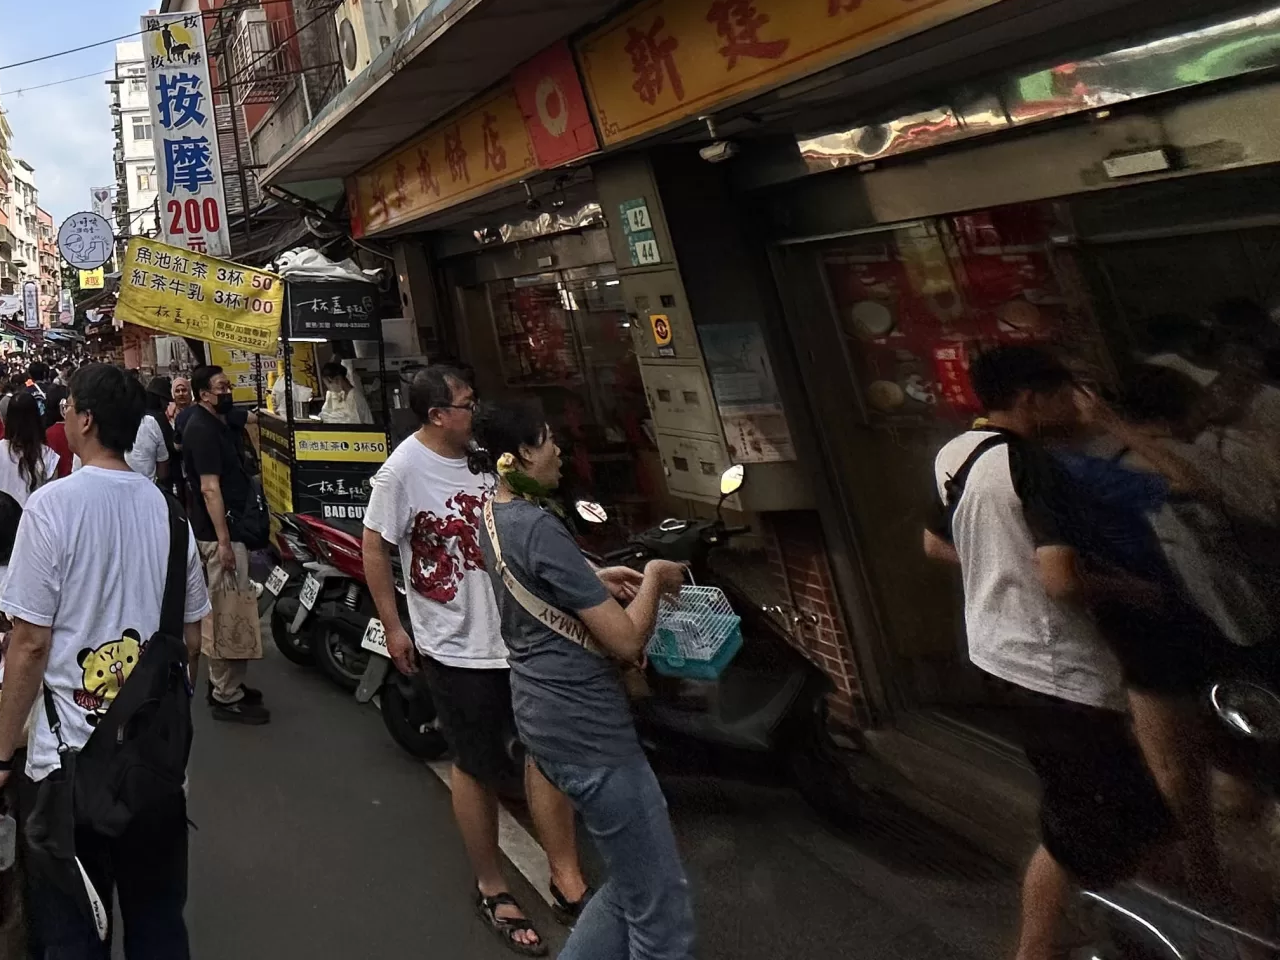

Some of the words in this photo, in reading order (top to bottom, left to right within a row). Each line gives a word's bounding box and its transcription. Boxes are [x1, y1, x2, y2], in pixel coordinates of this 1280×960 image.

[155, 71, 215, 194] 按摩
[166, 197, 220, 235] 200
[632, 209, 645, 228] 42
[187, 236, 208, 254] 元
[641, 243, 654, 261] 44
[135, 246, 209, 281] 魚池紅茶
[216, 267, 244, 287] 3杯
[251, 274, 273, 291] 50
[130, 268, 205, 302] 紅茶牛乳
[213, 289, 274, 314] 3杯100
[324, 504, 347, 519] BAD
